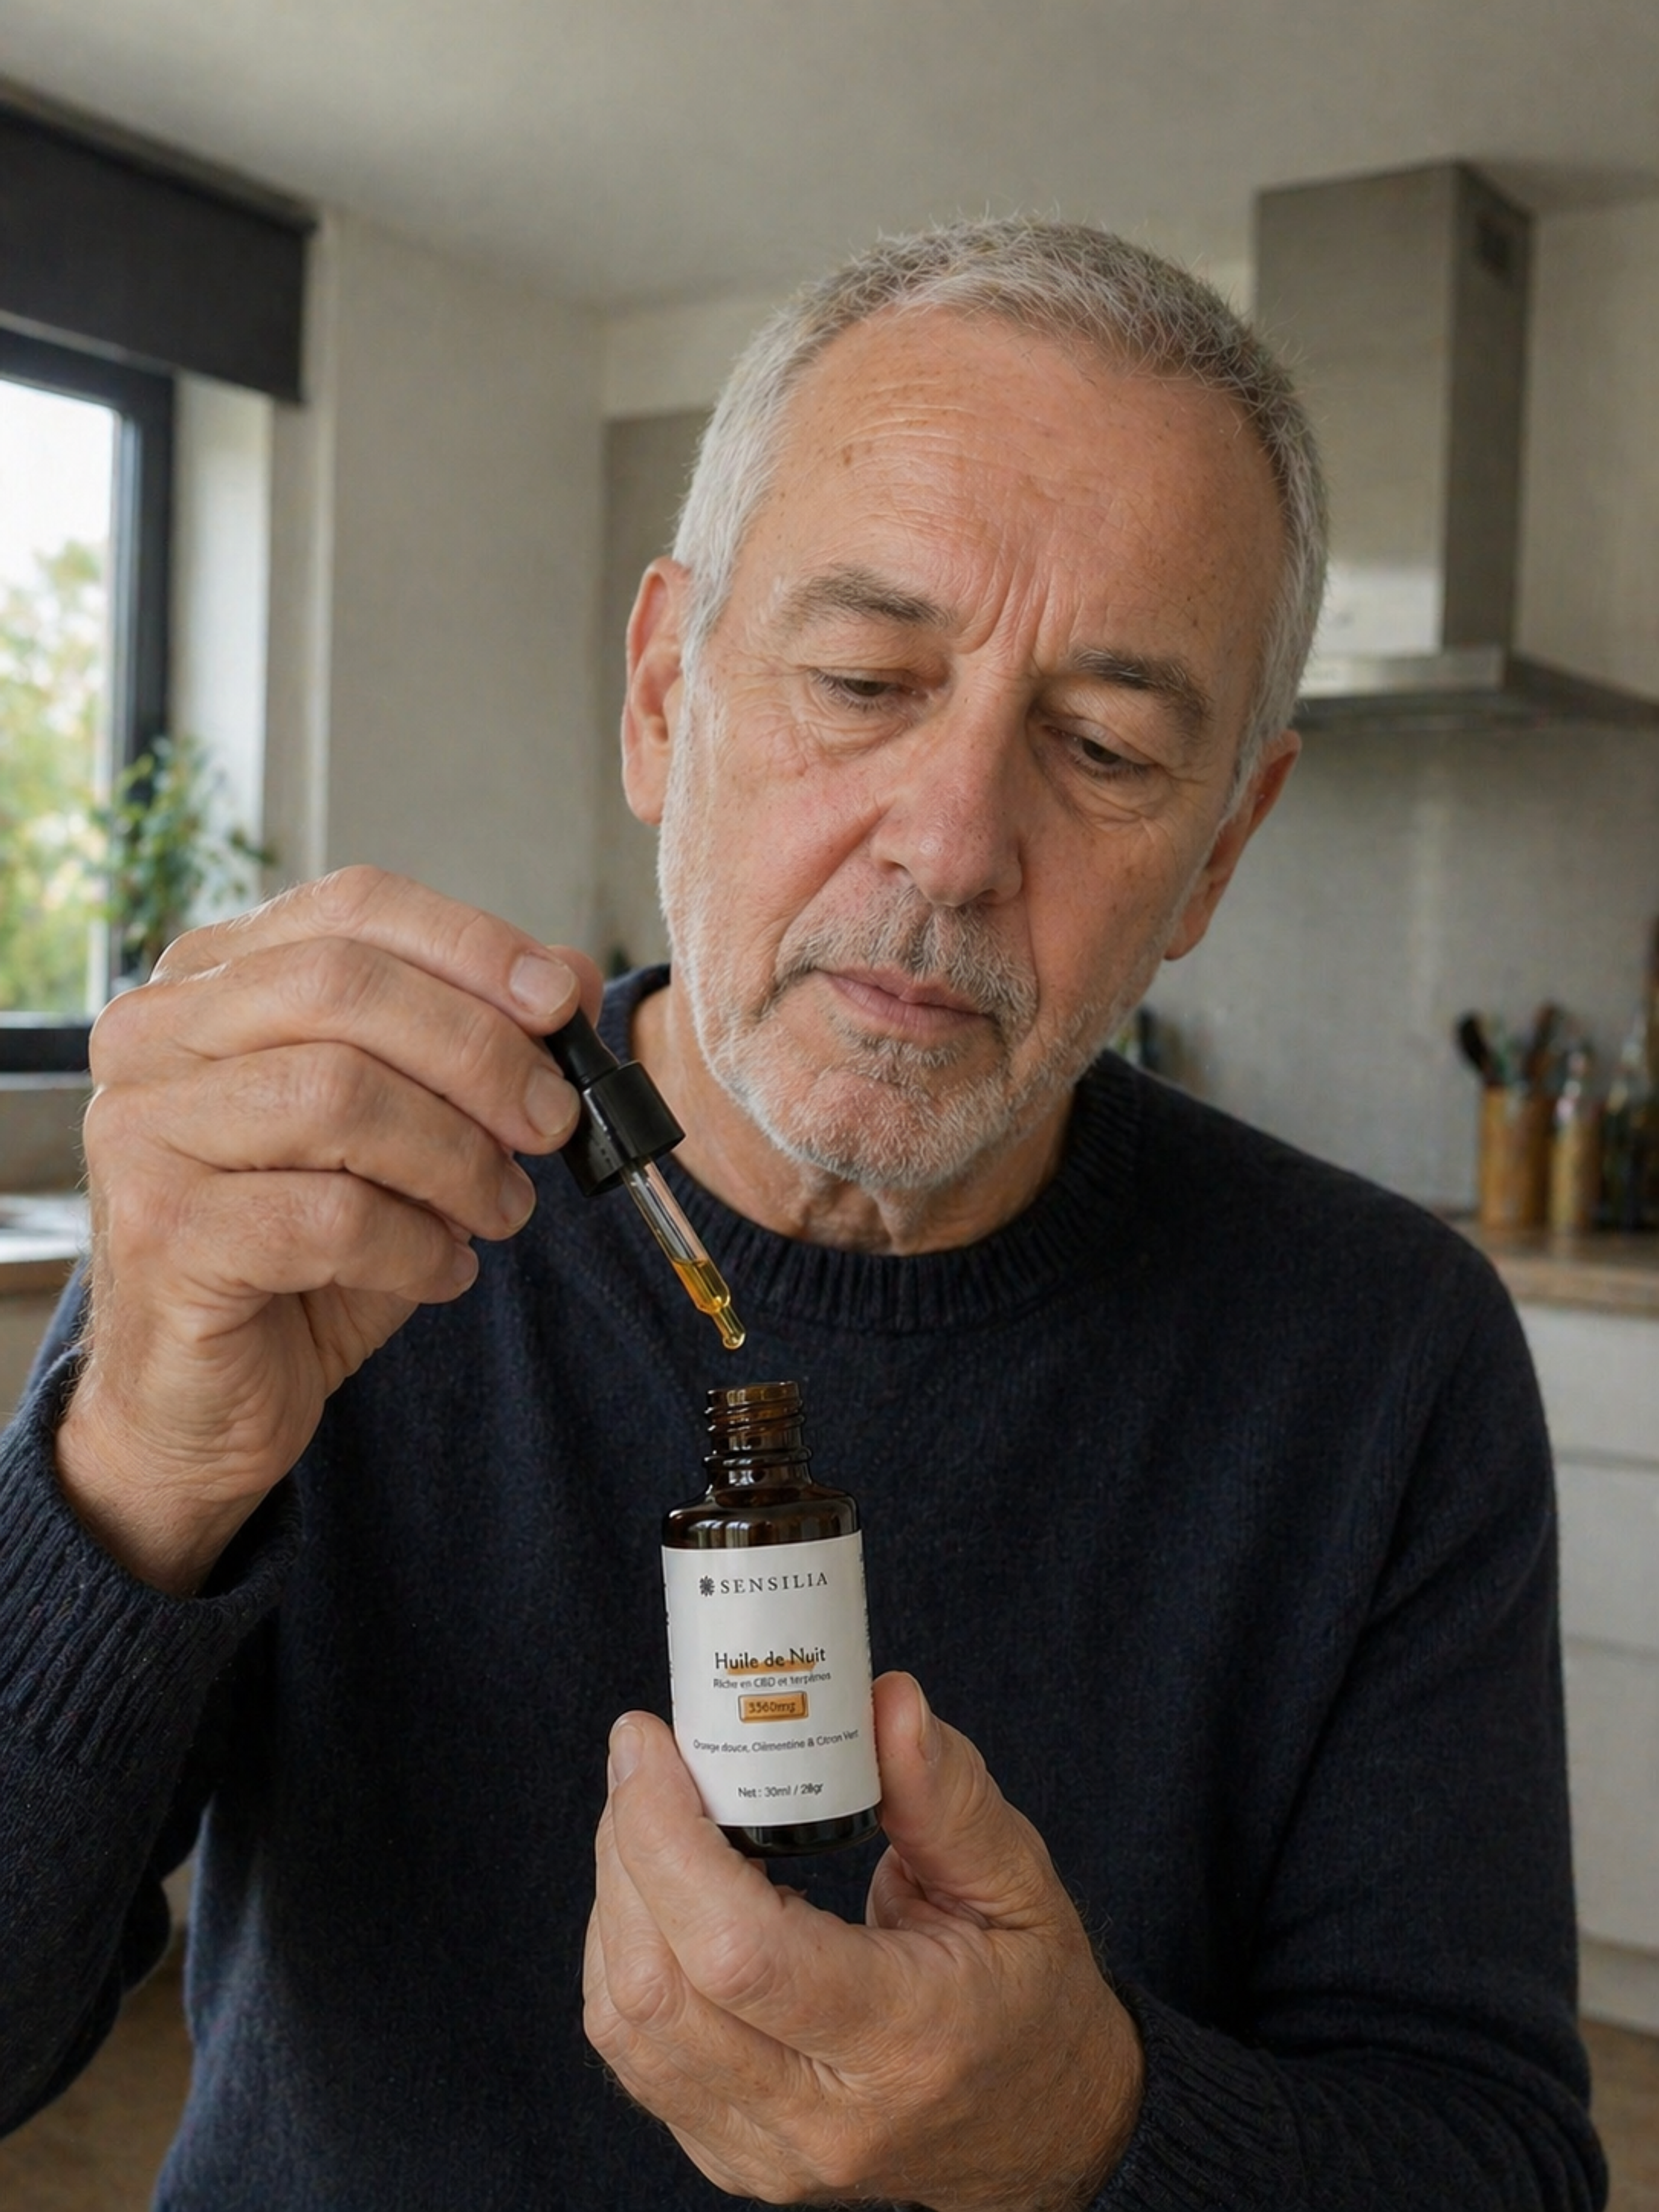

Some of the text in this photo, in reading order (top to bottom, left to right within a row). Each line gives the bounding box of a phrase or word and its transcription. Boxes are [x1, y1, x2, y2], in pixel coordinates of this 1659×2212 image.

[720, 1572, 828, 1594] SENSILIA
[715, 1647, 826, 1669] Huile de Nuit
[713, 1678, 737, 1689] Riche
[753, 1677, 775, 1688] CBD
[778, 1677, 788, 1687] et
[807, 1737, 815, 1747] &
[764, 1785, 791, 1798] 30ml
